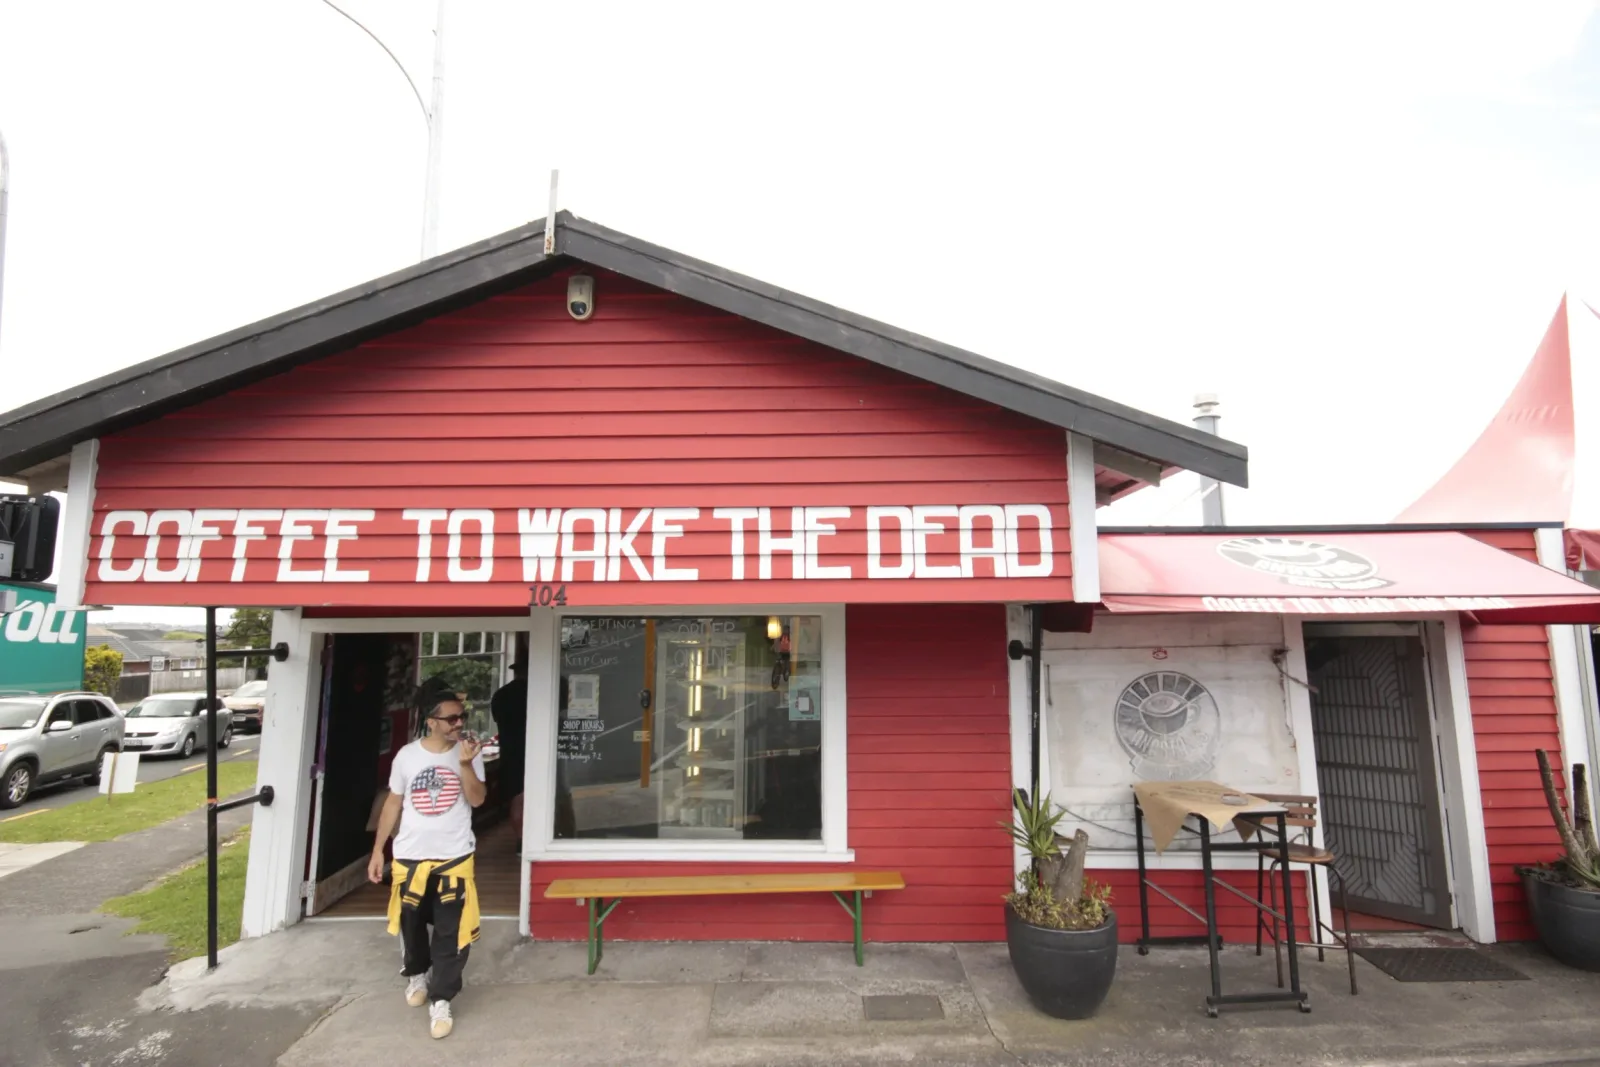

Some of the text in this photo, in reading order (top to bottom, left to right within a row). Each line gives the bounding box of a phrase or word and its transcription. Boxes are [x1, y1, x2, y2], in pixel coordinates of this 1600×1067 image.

[98, 504, 1054, 583] COFFEE TO WAKE THE DEAD
[528, 584, 567, 606] 104
[0, 600, 79, 643] OLL
[563, 719, 605, 730] SHOP HOURS
